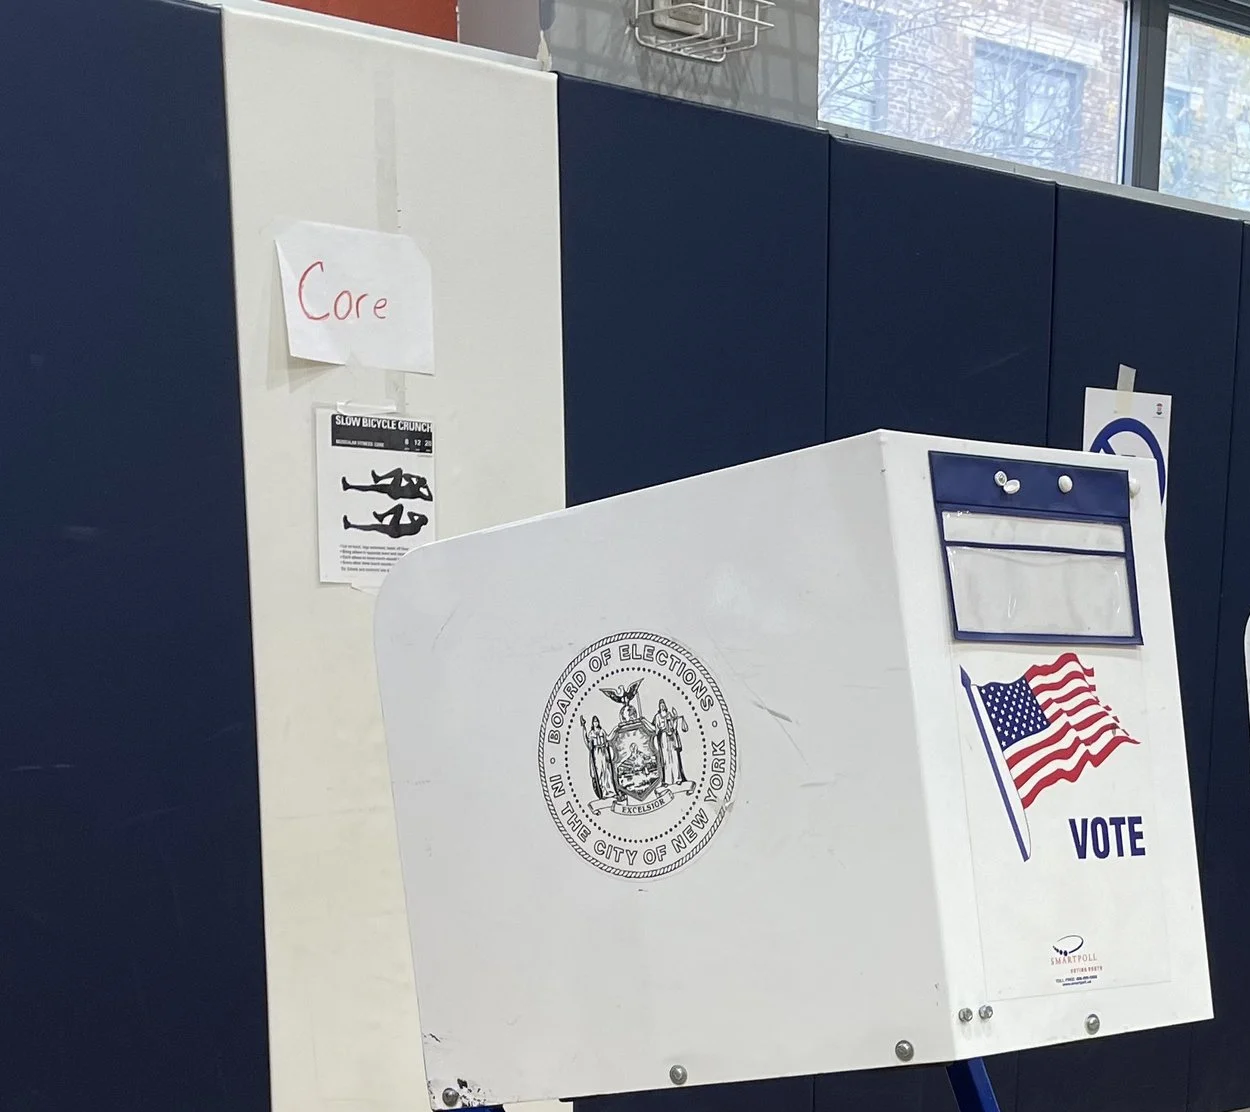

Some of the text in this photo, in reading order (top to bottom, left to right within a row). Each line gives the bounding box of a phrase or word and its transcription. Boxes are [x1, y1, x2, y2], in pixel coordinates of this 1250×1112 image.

[298, 261, 388, 321] Core
[335, 415, 361, 427] SLOW
[362, 418, 397, 430] BICYCLE
[548, 644, 715, 745] BOARD OF ELECTIONS
[549, 739, 726, 866] IN THE CITY OF NEW YORK
[622, 798, 666, 814] EXCELSIOR
[1068, 816, 1147, 860] VOTE
[1051, 953, 1097, 966] SMARTPOLL
